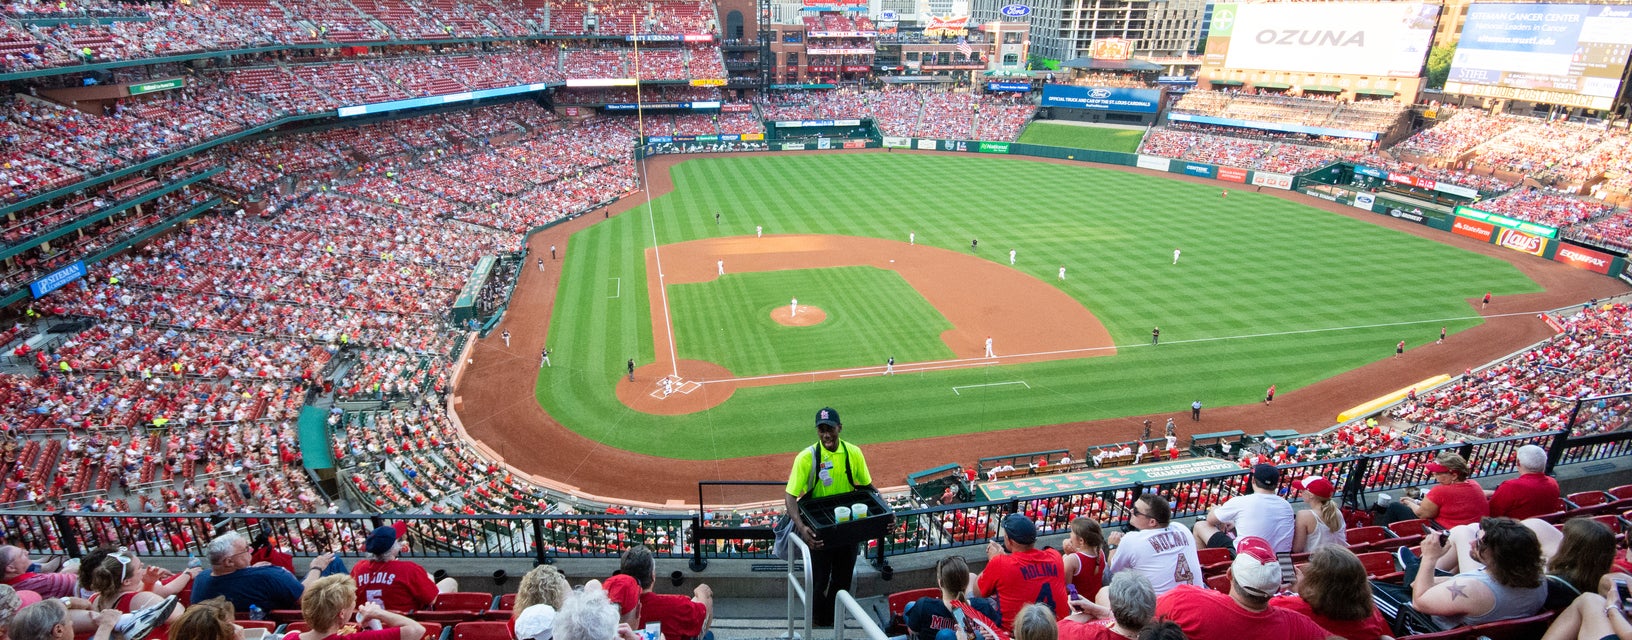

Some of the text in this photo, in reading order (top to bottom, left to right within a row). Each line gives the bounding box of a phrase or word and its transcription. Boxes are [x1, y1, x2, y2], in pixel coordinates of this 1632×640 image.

[1006, 6, 1027, 16] Ford
[1470, 12, 1580, 23] SITEMAN CANCER CENTER
[945, 28, 968, 36] HOUSE
[1504, 23, 1532, 31] Leaders
[1542, 24, 1568, 32] Cancer
[1255, 29, 1366, 47] OZUNA
[1459, 68, 1489, 80] STIFEL
[1090, 90, 1108, 98] Ford
[1560, 248, 1606, 267] EQUIFAX
[48, 263, 79, 283] SITEMAN
[1020, 564, 1058, 580] MOLINA
[1174, 552, 1194, 586] 4
[358, 572, 396, 586] PUJOLS
[366, 590, 385, 610] 5
[1034, 582, 1056, 618] 4
